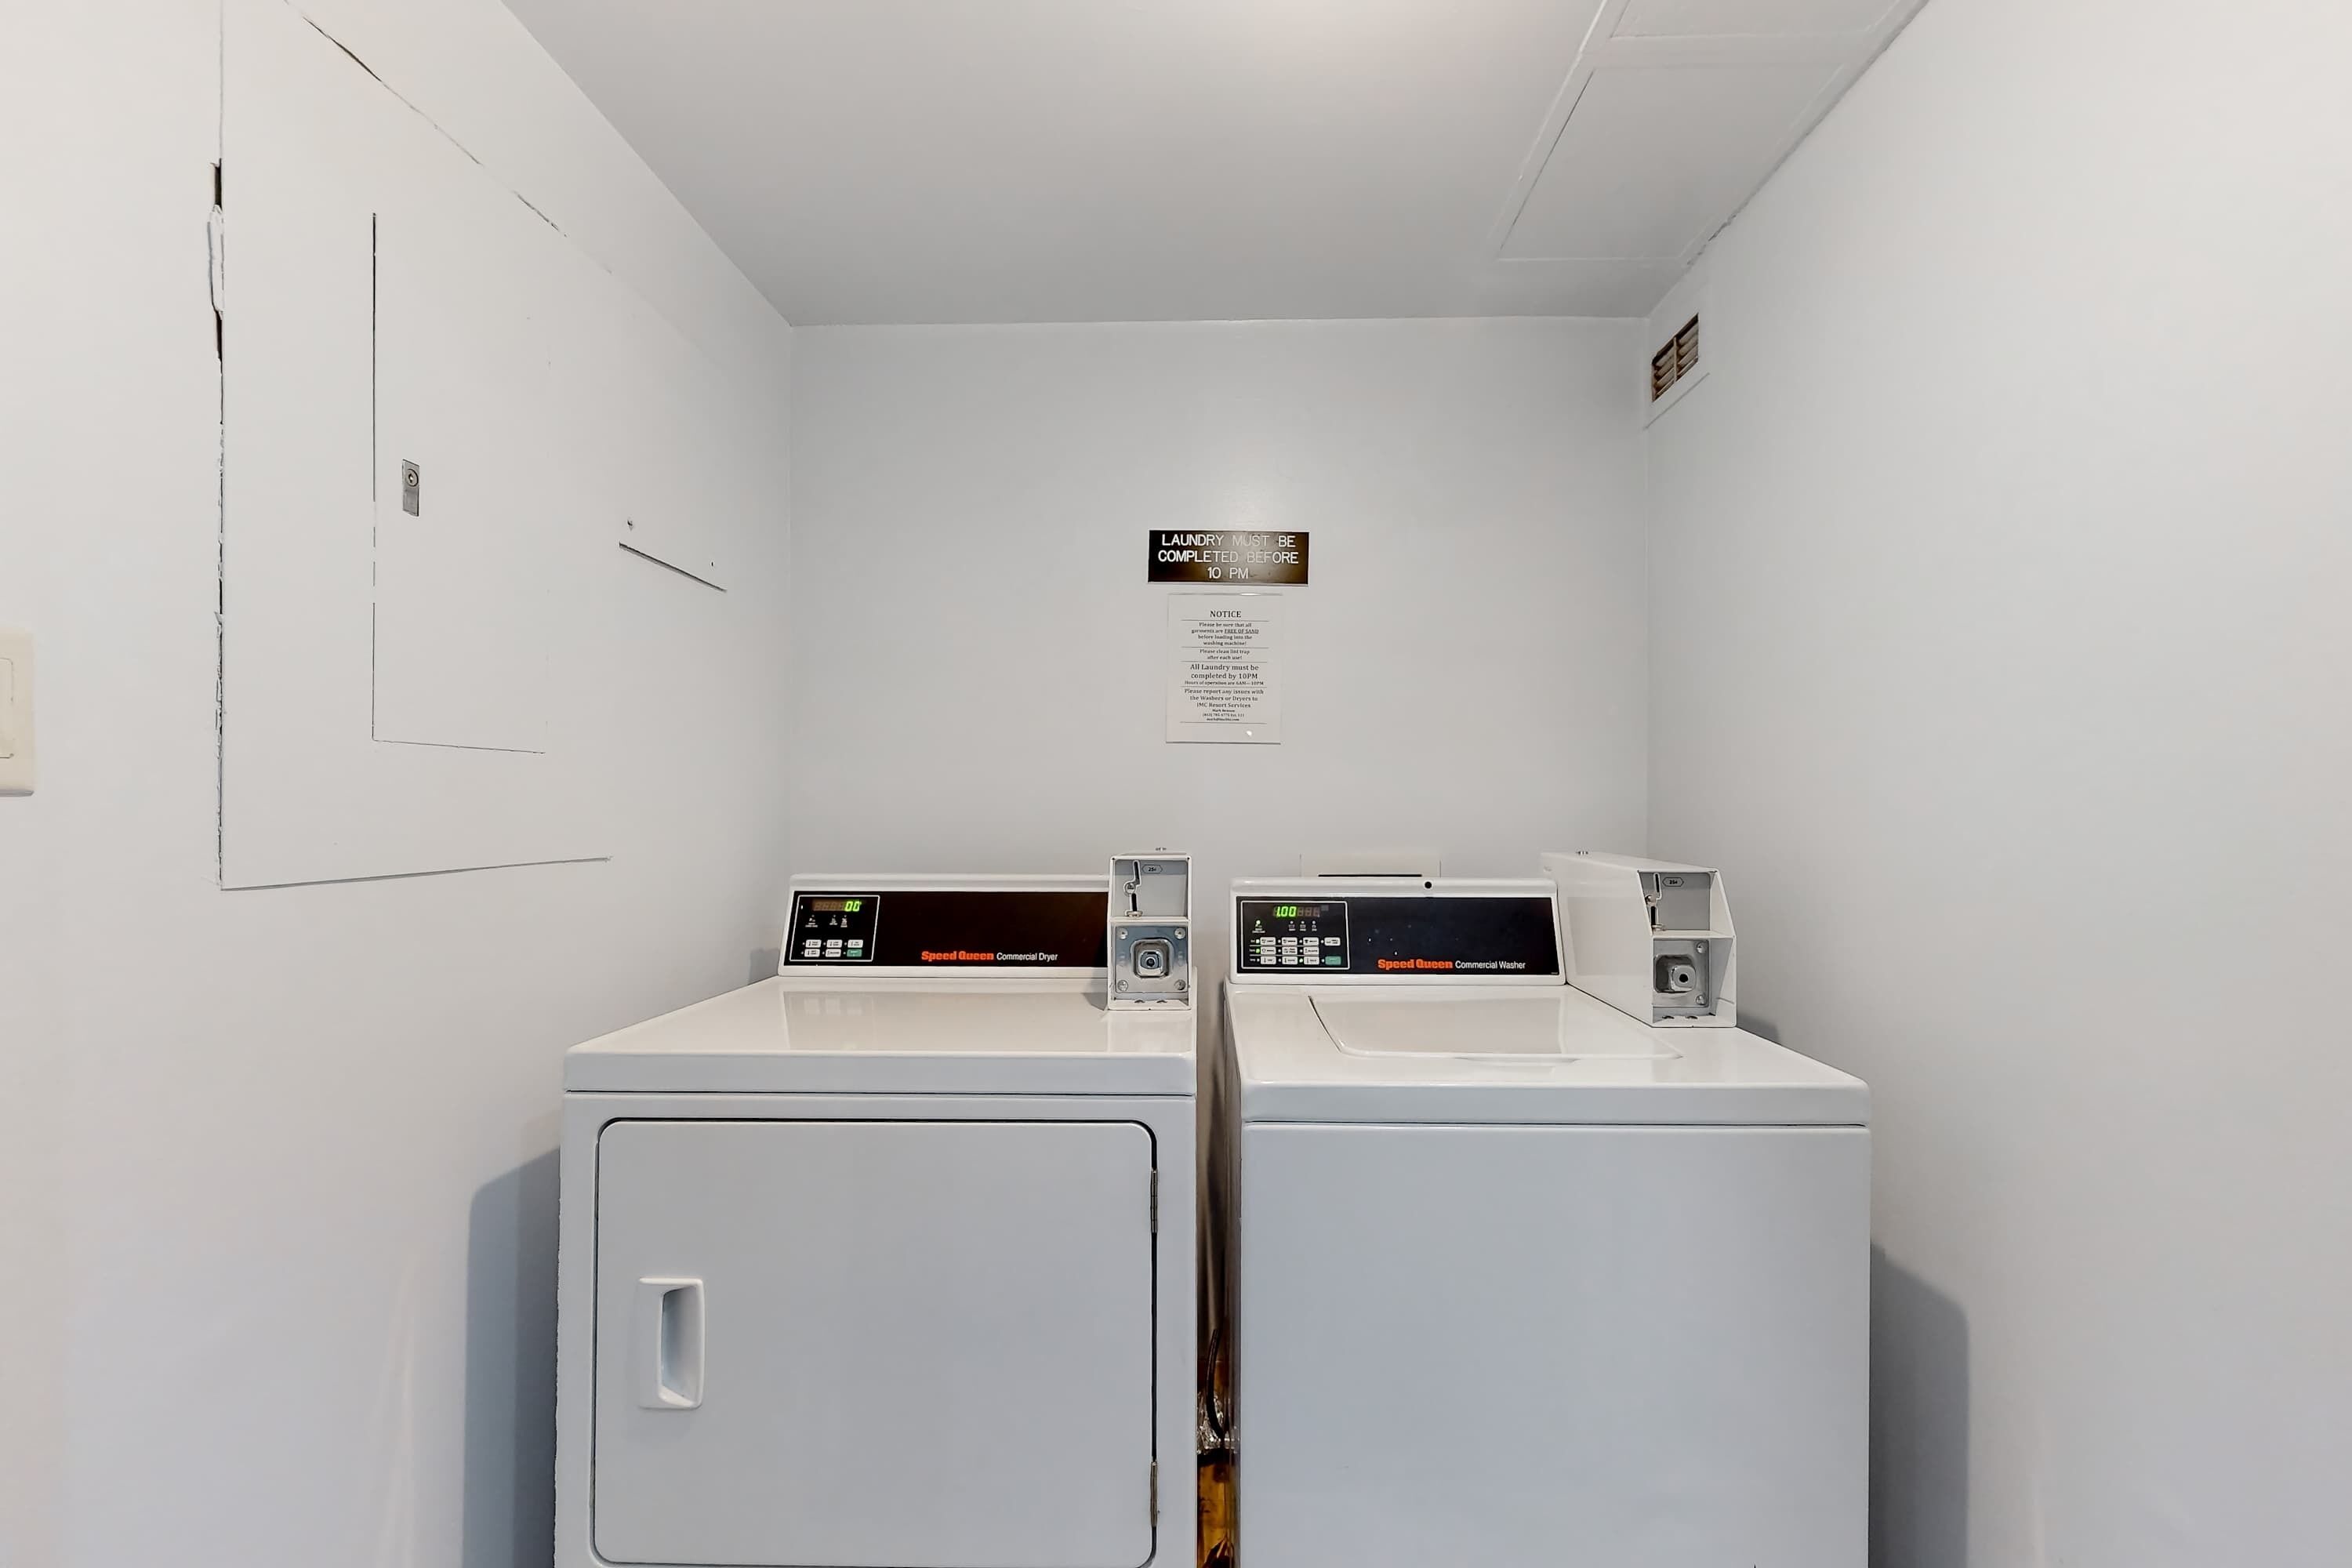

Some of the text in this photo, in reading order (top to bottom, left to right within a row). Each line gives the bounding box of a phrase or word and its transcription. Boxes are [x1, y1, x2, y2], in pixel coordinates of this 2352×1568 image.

[1162, 534, 1296, 547] LAUNDRY MUST BE
[1158, 550, 1299, 564] COMPLETED BEFORE
[1207, 567, 1249, 579] 10 PM
[921, 951, 1058, 962] Speed Queen Commercial Dryer
[1378, 959, 1526, 970] Speed Queen Commercial Washer
